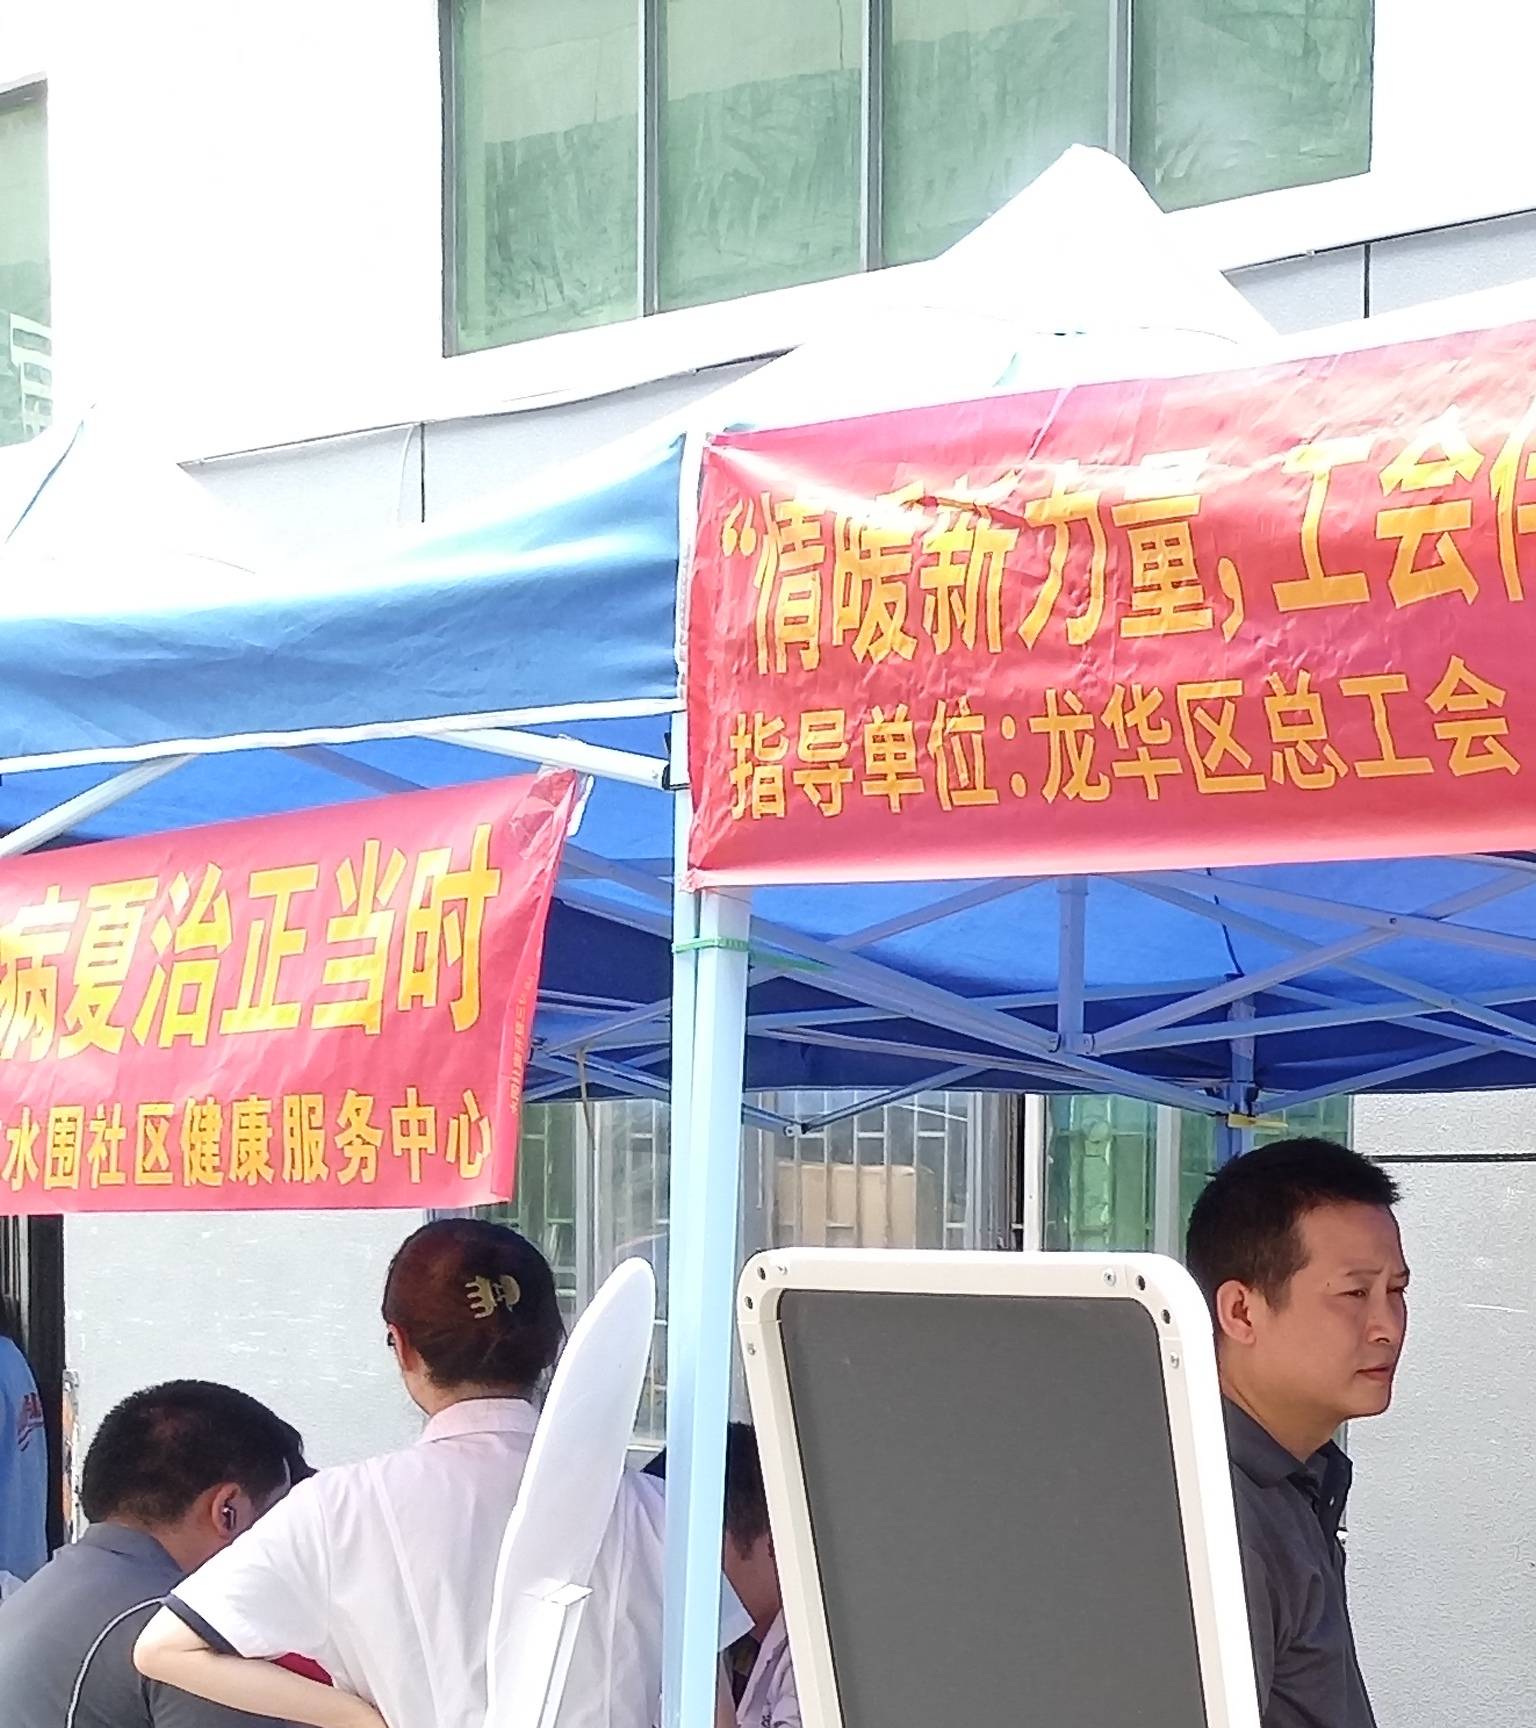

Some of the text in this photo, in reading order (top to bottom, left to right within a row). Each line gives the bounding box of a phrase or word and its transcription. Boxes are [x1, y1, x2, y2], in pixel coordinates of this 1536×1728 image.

[728, 654, 1521, 821] 指导单位：龙华区总工会
[0, 823, 501, 1063] 病夏治正当时
[1, 1087, 493, 1192] 水围社区健康服务中心
